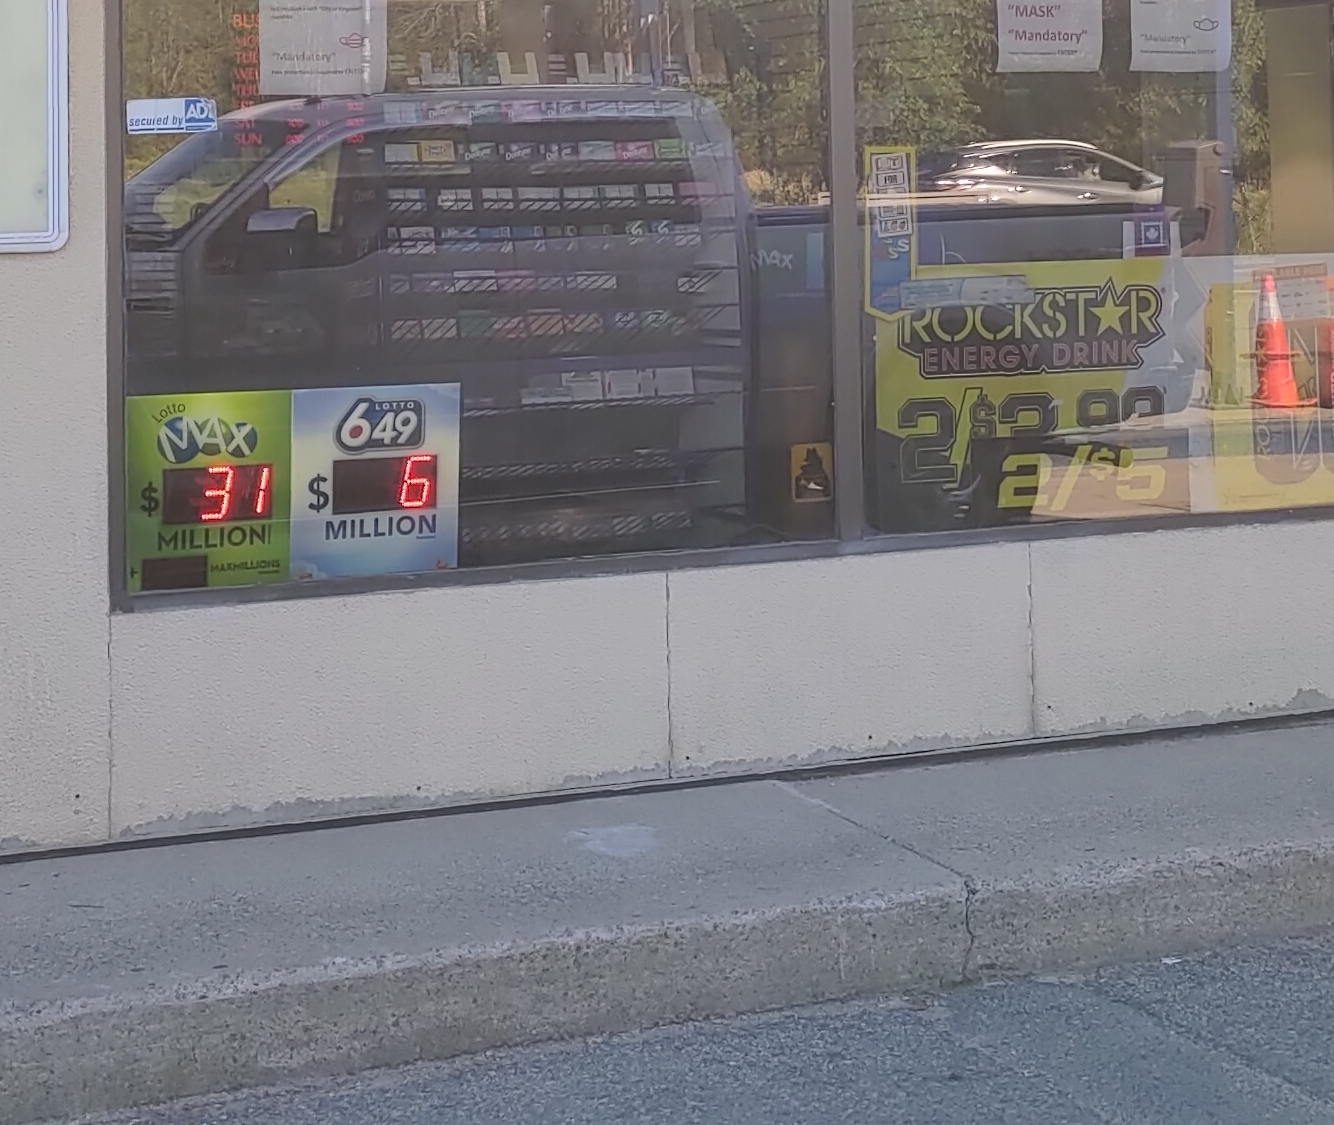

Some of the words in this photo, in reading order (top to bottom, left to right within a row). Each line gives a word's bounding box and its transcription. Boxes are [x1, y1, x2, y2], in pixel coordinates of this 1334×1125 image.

[1008, 4, 1061, 18] "MASK"
[1008, 29, 1088, 44] "Mandatory"
[272, 52, 336, 63] "Mandatory"
[129, 116, 169, 126] secured
[172, 116, 184, 127] by
[924, 344, 1038, 373] ENERGY
[1053, 339, 1138, 366] DRINK
[152, 402, 186, 423] Lotto
[375, 400, 415, 411] LOTTO
[157, 416, 257, 463] MAX
[400, 454, 432, 508] 6
[200, 465, 270, 521] 31
[325, 513, 437, 540] MILLION
[157, 525, 266, 552] MILLION
[210, 559, 281, 573] MAXMILLIONS
